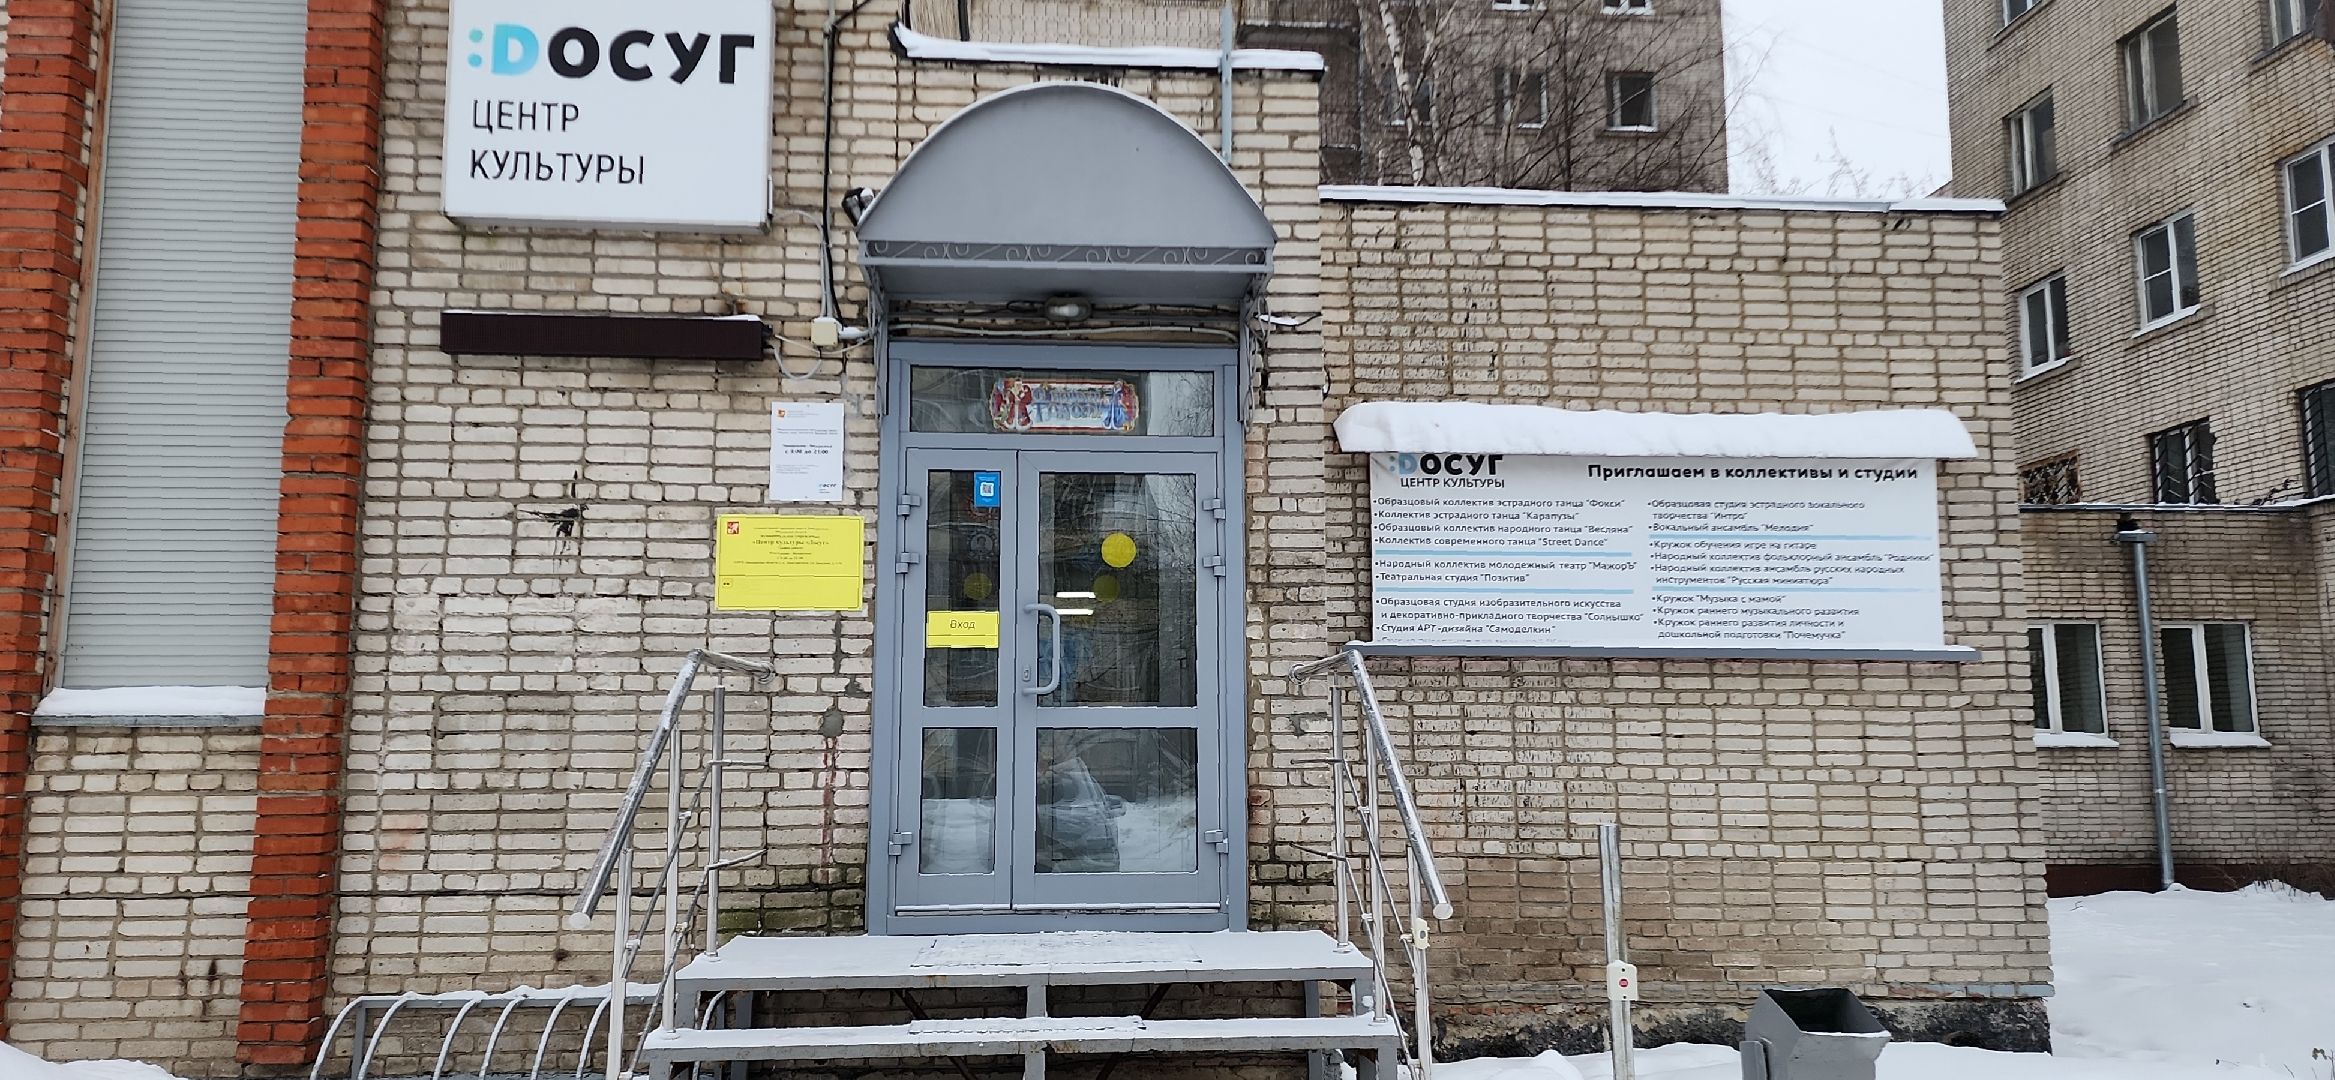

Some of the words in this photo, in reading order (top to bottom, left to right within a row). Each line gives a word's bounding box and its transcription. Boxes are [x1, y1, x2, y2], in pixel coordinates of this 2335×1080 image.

[472, 99, 580, 134] ЦЕНТР
[469, 149, 645, 184] КУЛЬТУРЫ
[1587, 464, 1705, 481] Приглашаем
[1710, 468, 1720, 478] в
[1725, 468, 1833, 479] коллективы
[1838, 469, 1849, 479] и
[1854, 469, 1917, 482] студии
[1400, 478, 1440, 488] ЦЕНТР
[1443, 478, 1505, 488] КУЛЬТУРЫ
[1377, 497, 1440, 507] Образцовый
[1497, 500, 1553, 508] эстрадного
[1555, 500, 1584, 508] танца
[1651, 499, 1711, 508] Образцовая
[1714, 502, 1746, 510] студия
[1378, 510, 1431, 519] Коллектив
[1433, 511, 1489, 520] эстрадного
[1492, 512, 1520, 520] танца
[1378, 523, 1440, 533] Образцовый
[1498, 525, 1551, 534] народного
[1554, 526, 1582, 534] танца
[1379, 536, 1431, 545] Коллектив
[1434, 538, 1505, 546] современного
[1653, 541, 1691, 549] Кружок
[1655, 552, 1706, 561] Народный
[1709, 553, 1761, 561] коллектив
[1379, 560, 1431, 569] Народный
[1434, 561, 1486, 569] коллектив
[1559, 562, 1587, 571] театр
[1655, 564, 1706, 572] Народный
[1710, 565, 1761, 573] коллектив
[1380, 572, 1442, 582] Театральная
[1445, 575, 1478, 583] студия
[1380, 597, 1440, 607] Образцовая
[1443, 599, 1476, 608] студия
[1479, 598, 1571, 608] изобразительного
[1573, 601, 1621, 609] искусства
[1656, 594, 1694, 603] Кружок
[1657, 606, 1695, 615] Кружок
[1698, 608, 1738, 616] раннего
[1526, 613, 1582, 622] творчества
[1658, 618, 1695, 627] Кружок
[950, 619, 976, 631] Вход
[1380, 623, 1415, 632] Студия
